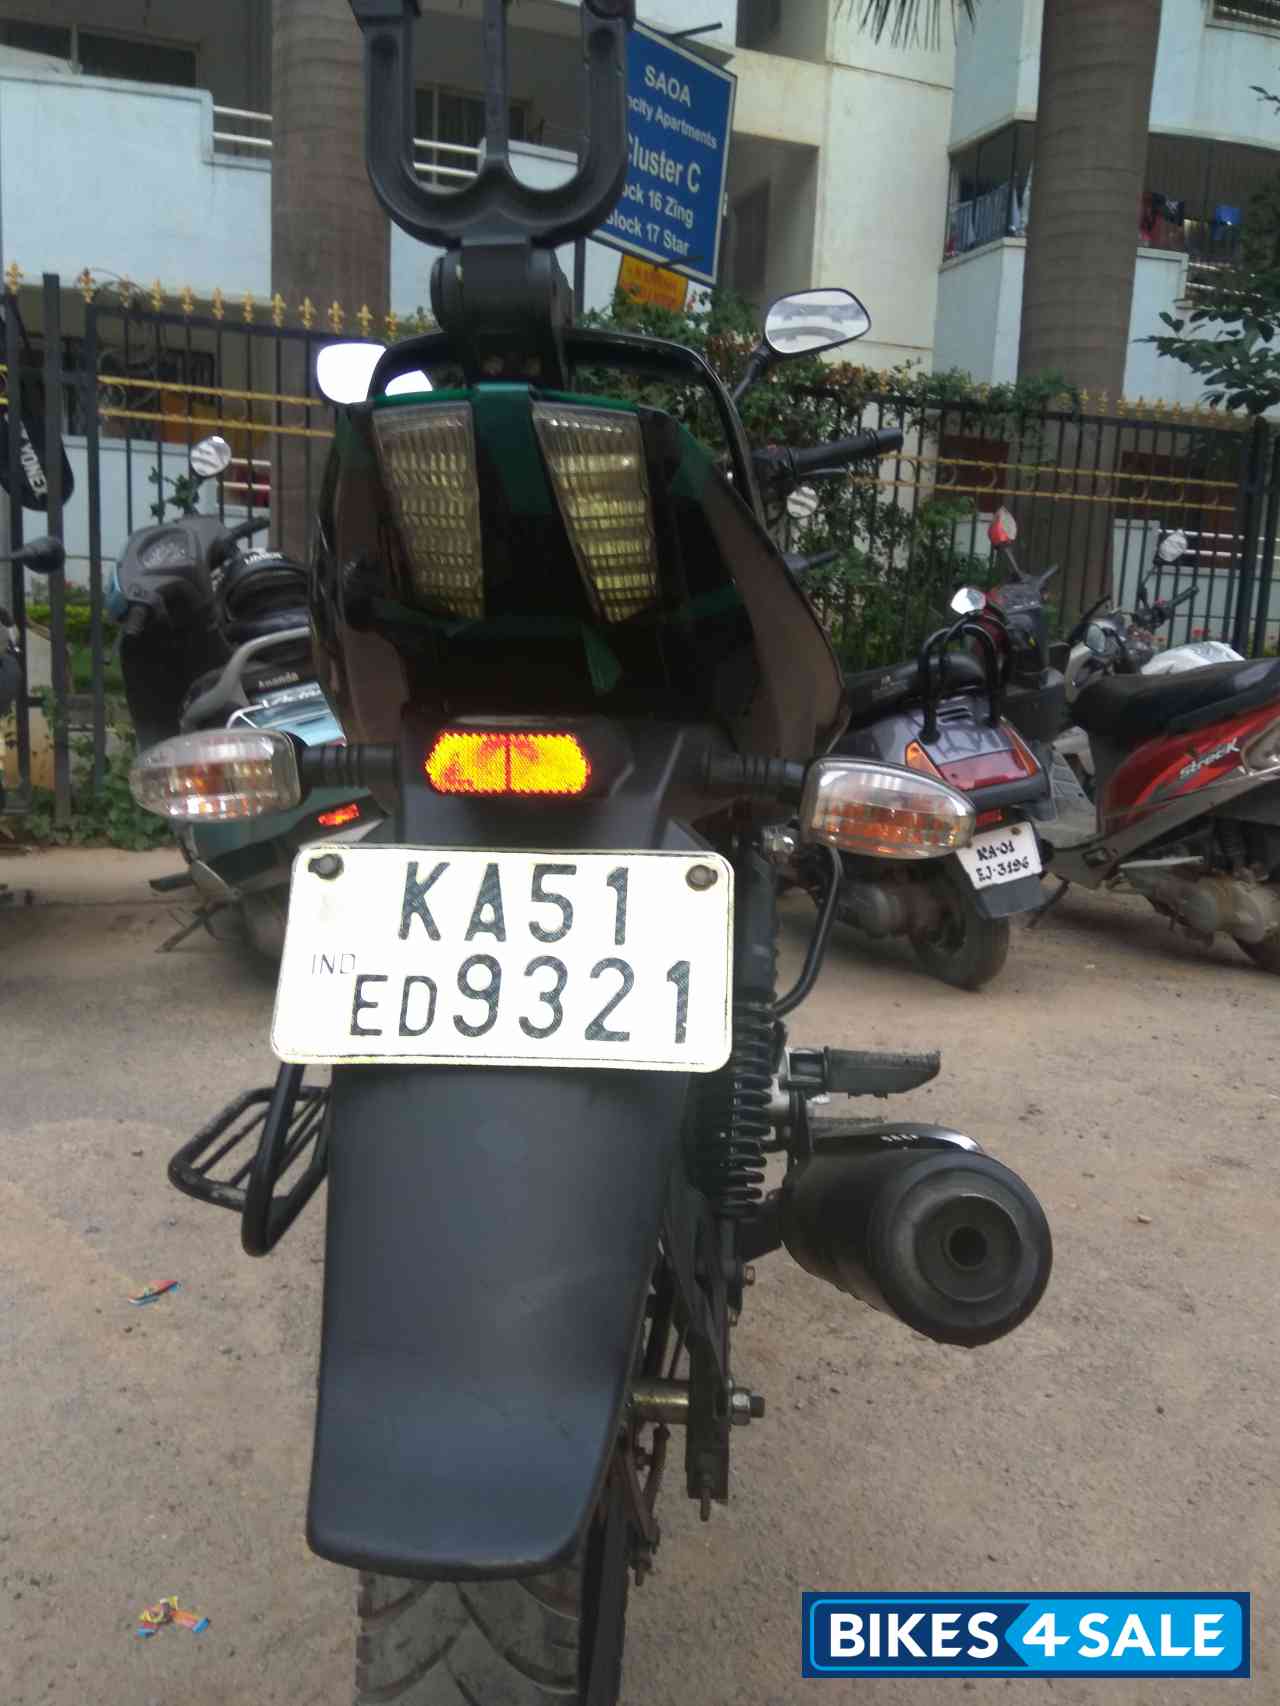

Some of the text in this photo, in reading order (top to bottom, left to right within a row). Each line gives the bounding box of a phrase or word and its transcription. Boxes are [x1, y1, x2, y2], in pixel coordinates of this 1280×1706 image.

[644, 64, 692, 108] SAOA
[655, 105, 717, 149] Apartments
[628, 132, 701, 193] luster C
[648, 190, 663, 211] 16
[664, 195, 694, 229] Zing
[646, 223, 660, 246] 17
[663, 229, 688, 256] Star
[976, 840, 1015, 861] KA-01
[311, 952, 356, 975] IND
